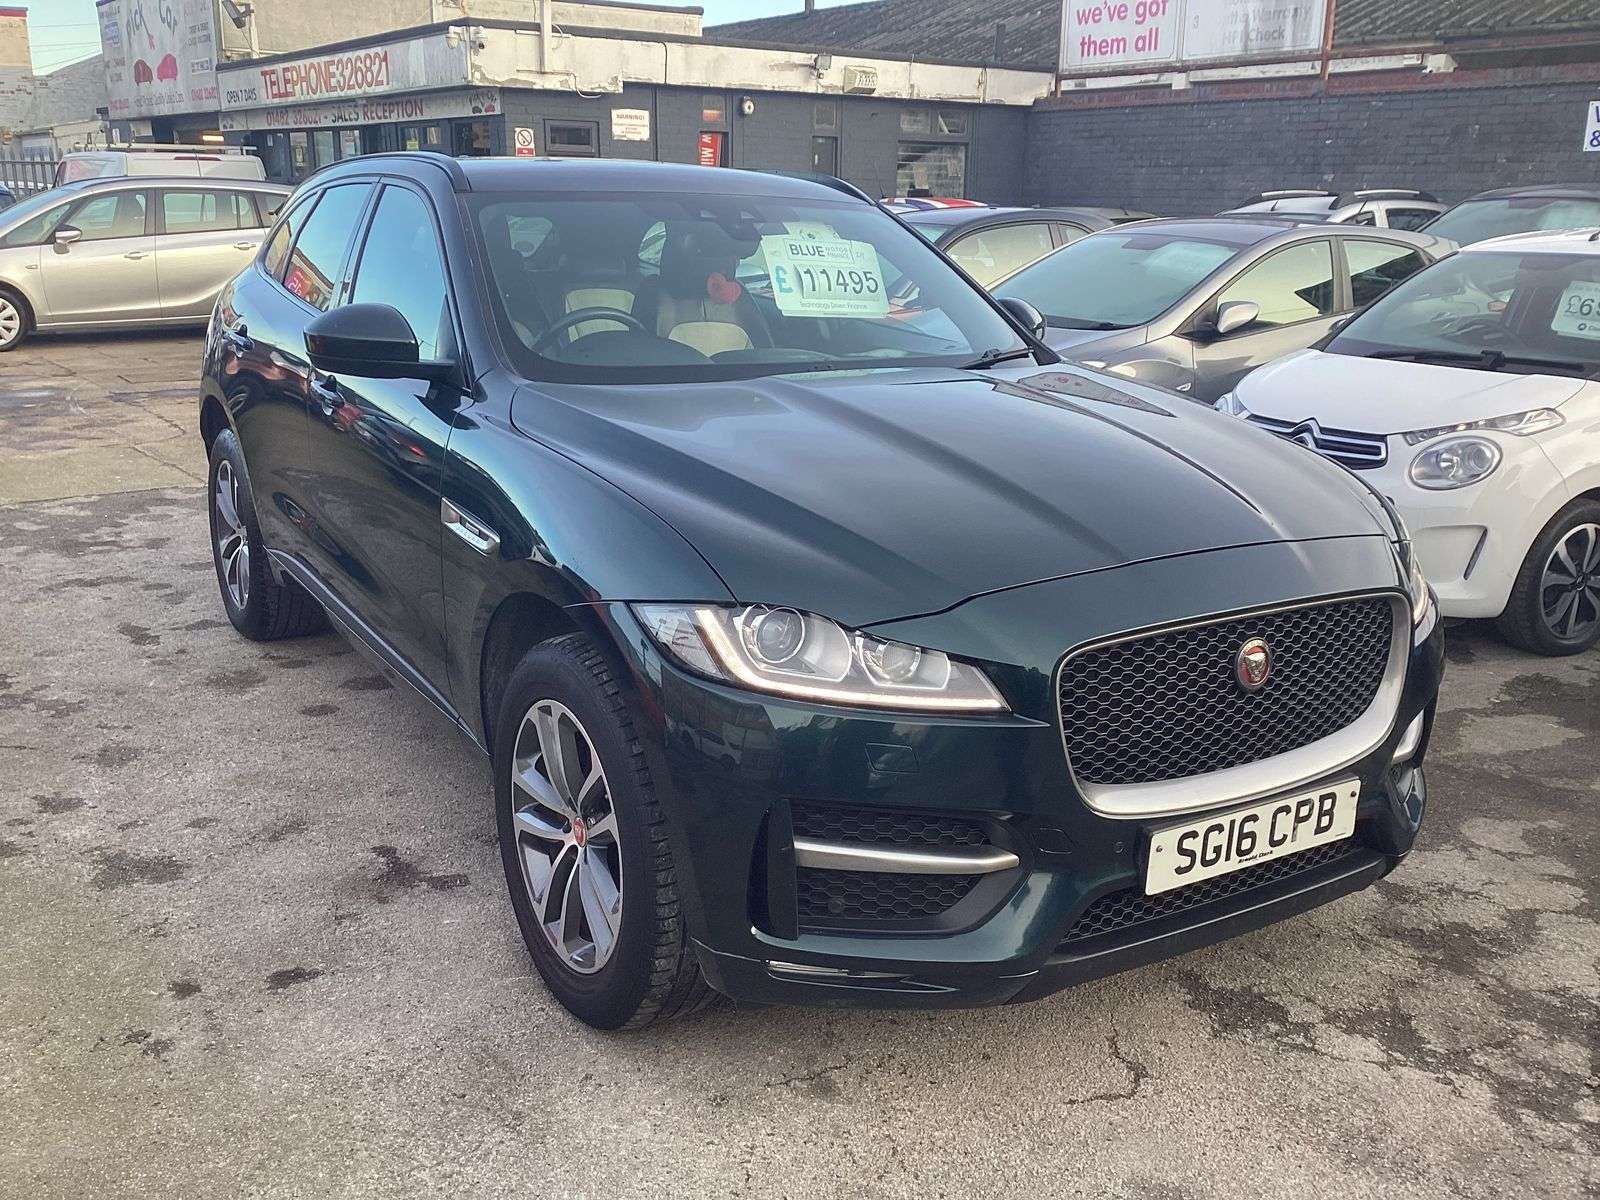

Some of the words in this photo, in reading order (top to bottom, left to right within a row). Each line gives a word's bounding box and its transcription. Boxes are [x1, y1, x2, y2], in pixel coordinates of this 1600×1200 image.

[1076, 0, 1128, 26] we've
[1134, 0, 1169, 24] got
[1079, 33, 1127, 58] them
[1134, 27, 1159, 52] all
[226, 91, 240, 104] OPEN
[244, 88, 257, 101] DAYS
[331, 103, 359, 124] SALES
[362, 99, 424, 122] RECEPTION
[616, 113, 645, 121] WARNING!
[789, 243, 826, 258] BLUE
[1174, 812, 1260, 876] SG16
[1268, 791, 1338, 849] CPB
